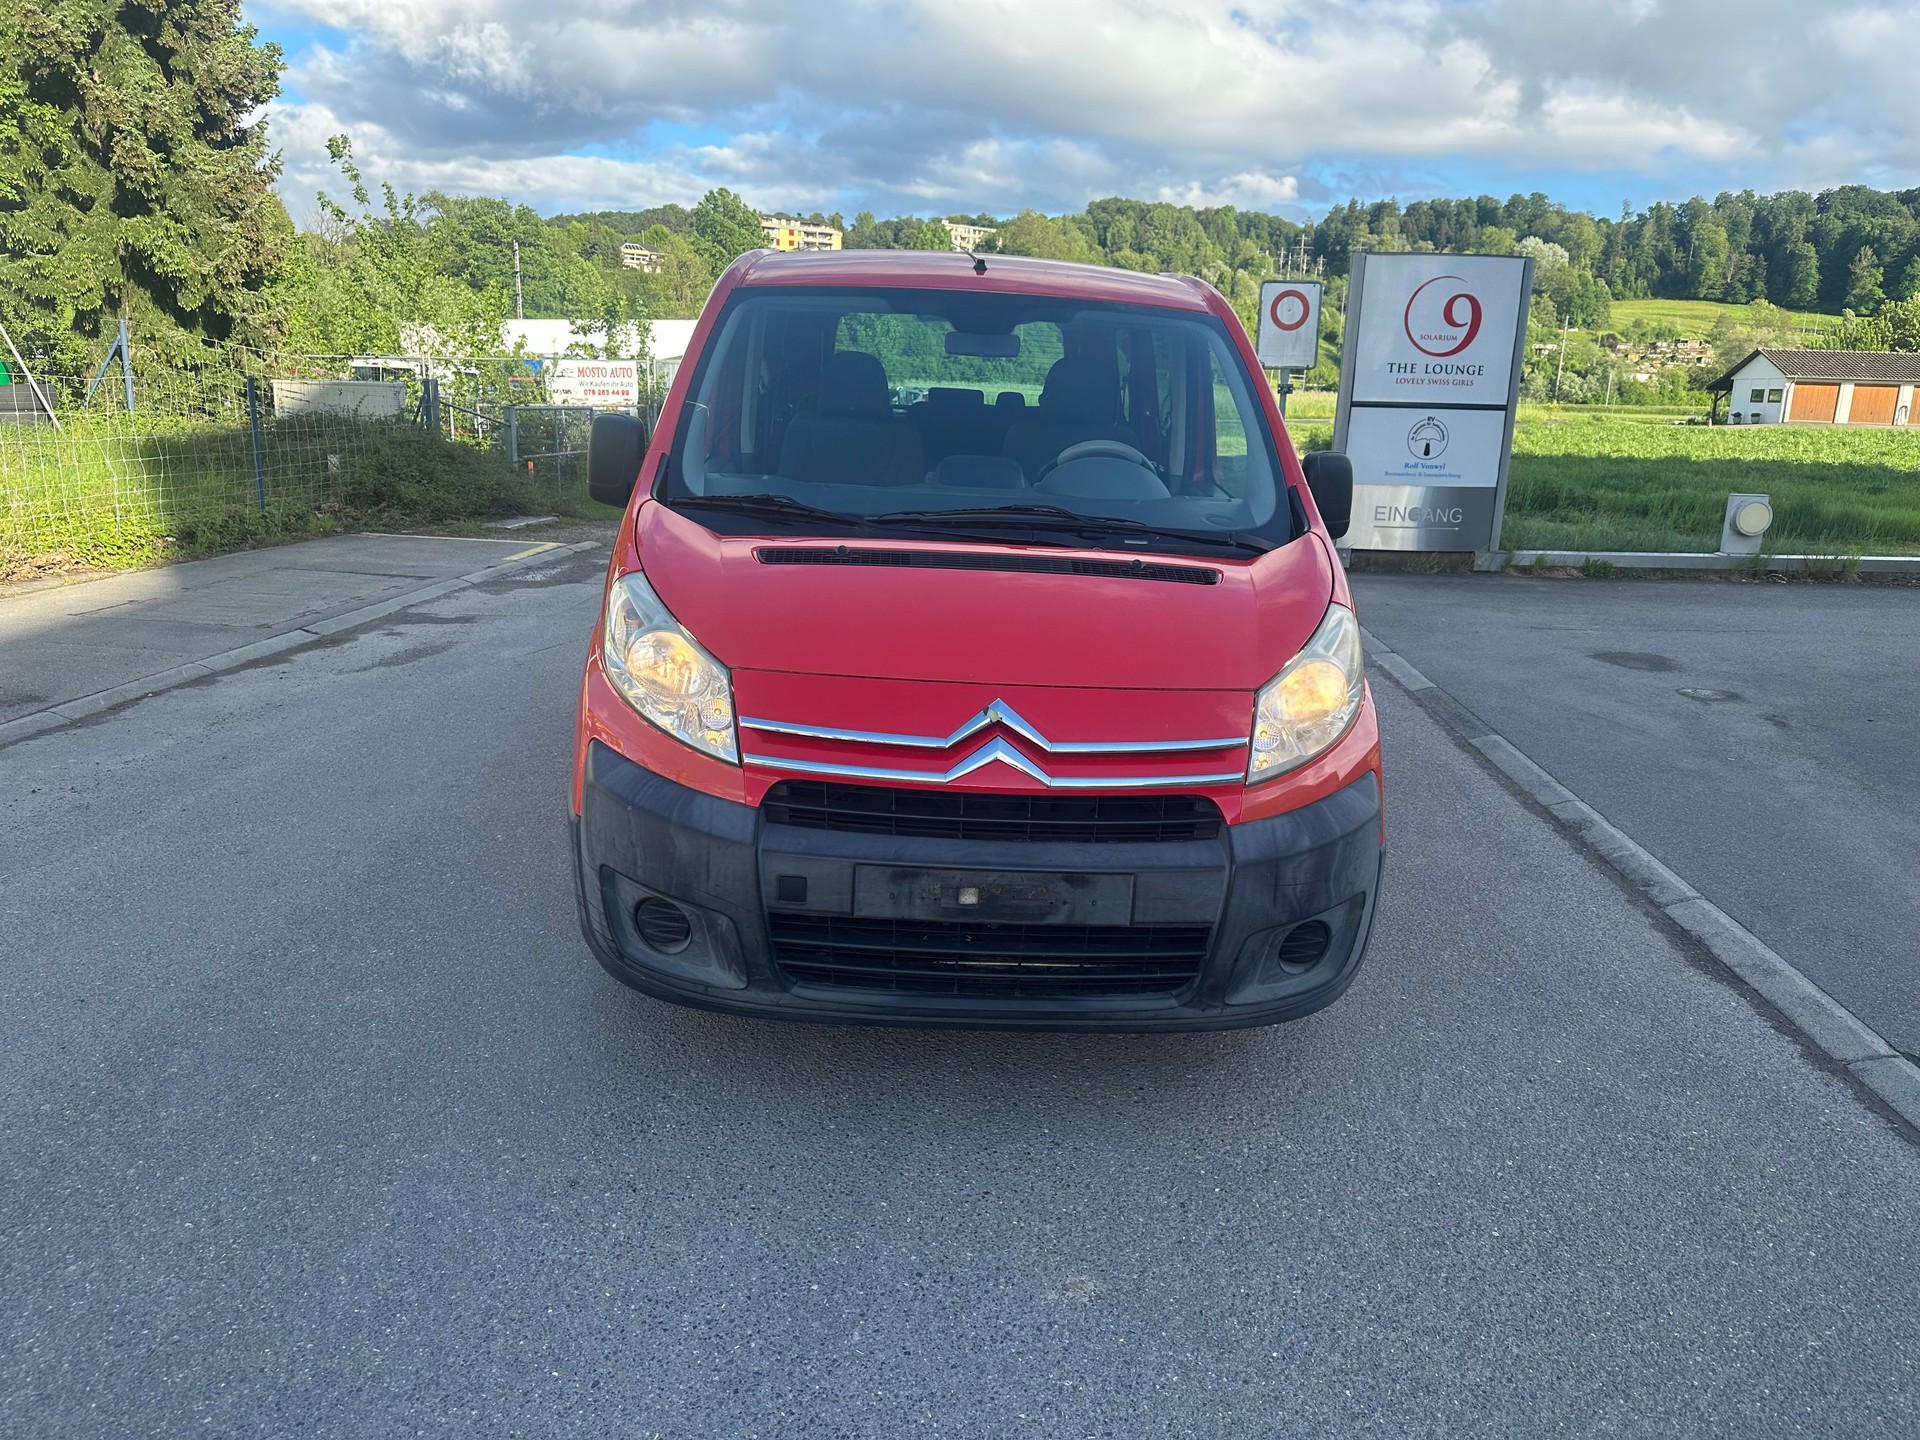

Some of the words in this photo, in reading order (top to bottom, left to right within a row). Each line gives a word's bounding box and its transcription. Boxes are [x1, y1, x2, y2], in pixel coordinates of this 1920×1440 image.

[1419, 333, 1458, 341] SOLARIUM
[577, 366, 608, 378] MOSTO
[609, 367, 633, 378] AUTO
[1387, 362, 1417, 374] THE
[1424, 363, 1485, 376] LOUNGE
[590, 380, 610, 388] Kaufen
[620, 380, 634, 388] Auto
[1395, 377, 1425, 385] LOVELY
[1427, 378, 1450, 386] SWISS
[1452, 379, 1474, 387] GIRLS
[1420, 462, 1446, 471] Vonwyl
[1374, 505, 1463, 523] EINGANG
